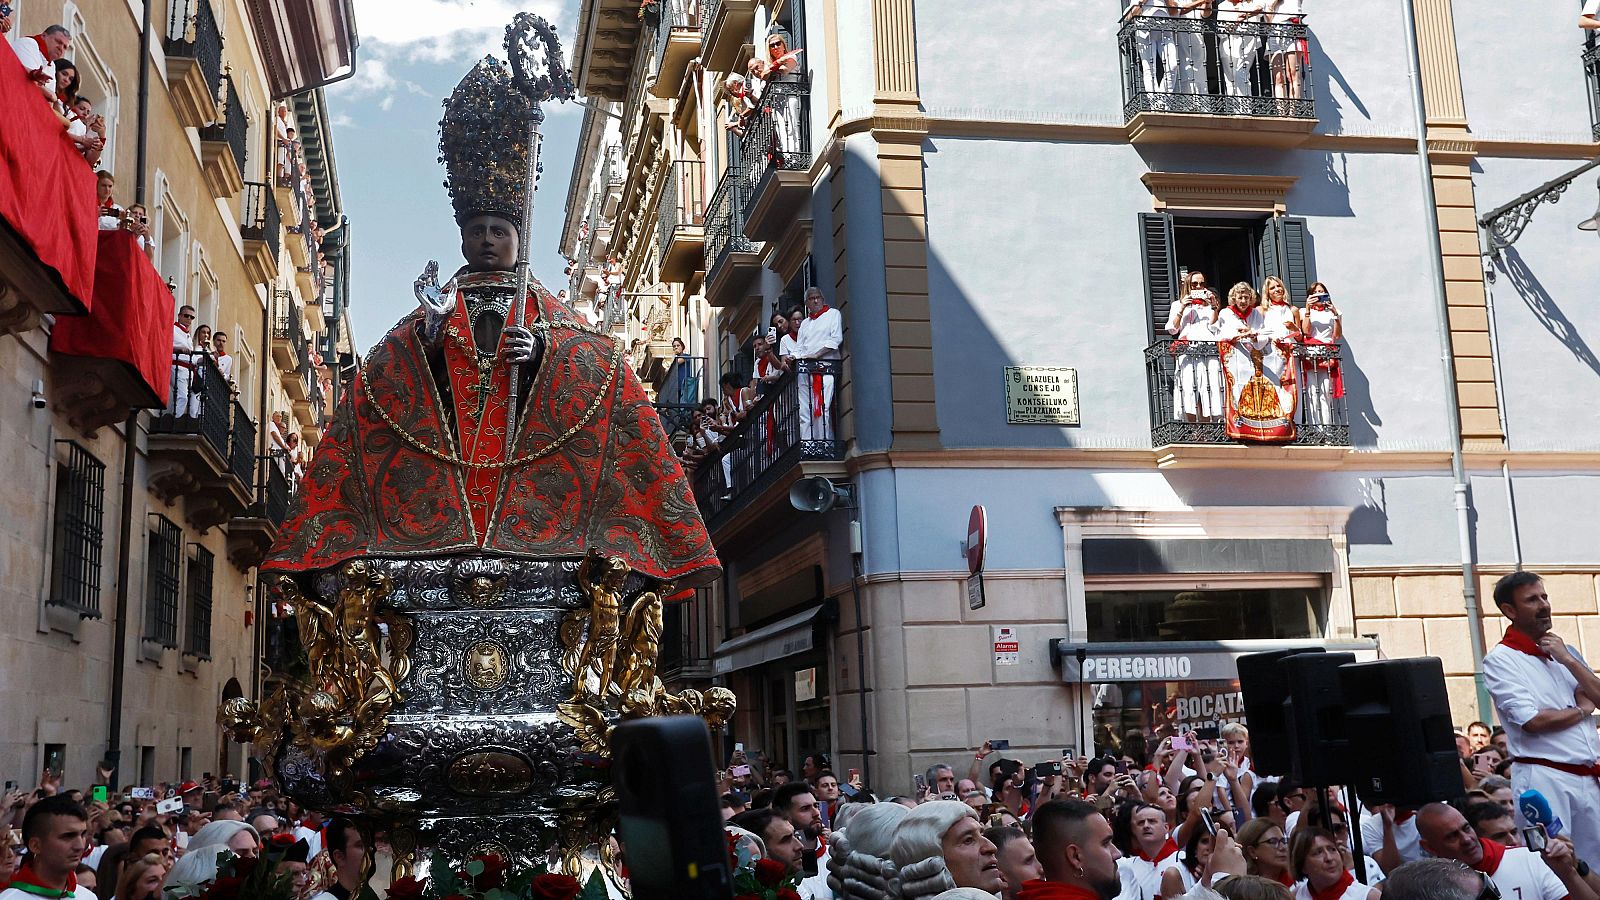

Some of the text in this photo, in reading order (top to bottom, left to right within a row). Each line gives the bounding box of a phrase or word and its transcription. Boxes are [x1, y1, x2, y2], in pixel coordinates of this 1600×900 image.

[1026, 375, 1060, 383] PLAZUELA
[1022, 384, 1061, 392] CONSEJO
[1082, 656, 1191, 679] PEREGRINO
